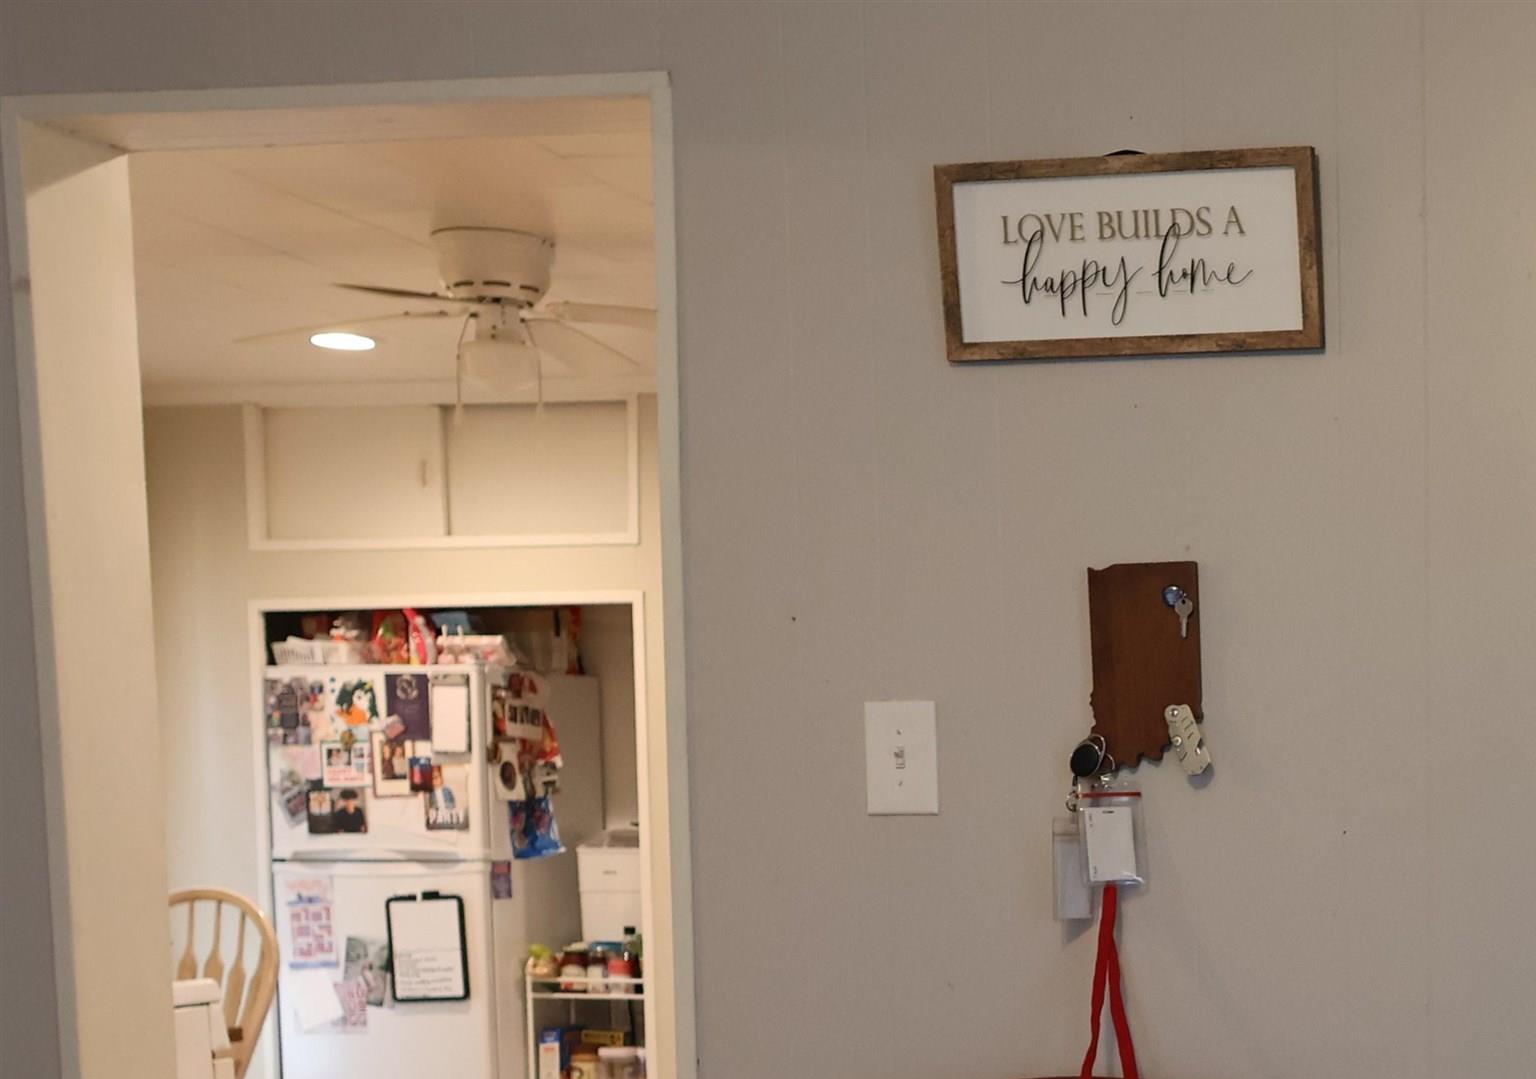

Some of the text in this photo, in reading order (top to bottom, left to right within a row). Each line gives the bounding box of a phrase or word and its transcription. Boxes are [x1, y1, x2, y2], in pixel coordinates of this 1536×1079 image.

[1001, 204, 1246, 245] LOVE BUILDS A
[1001, 222, 1254, 326] happy home
